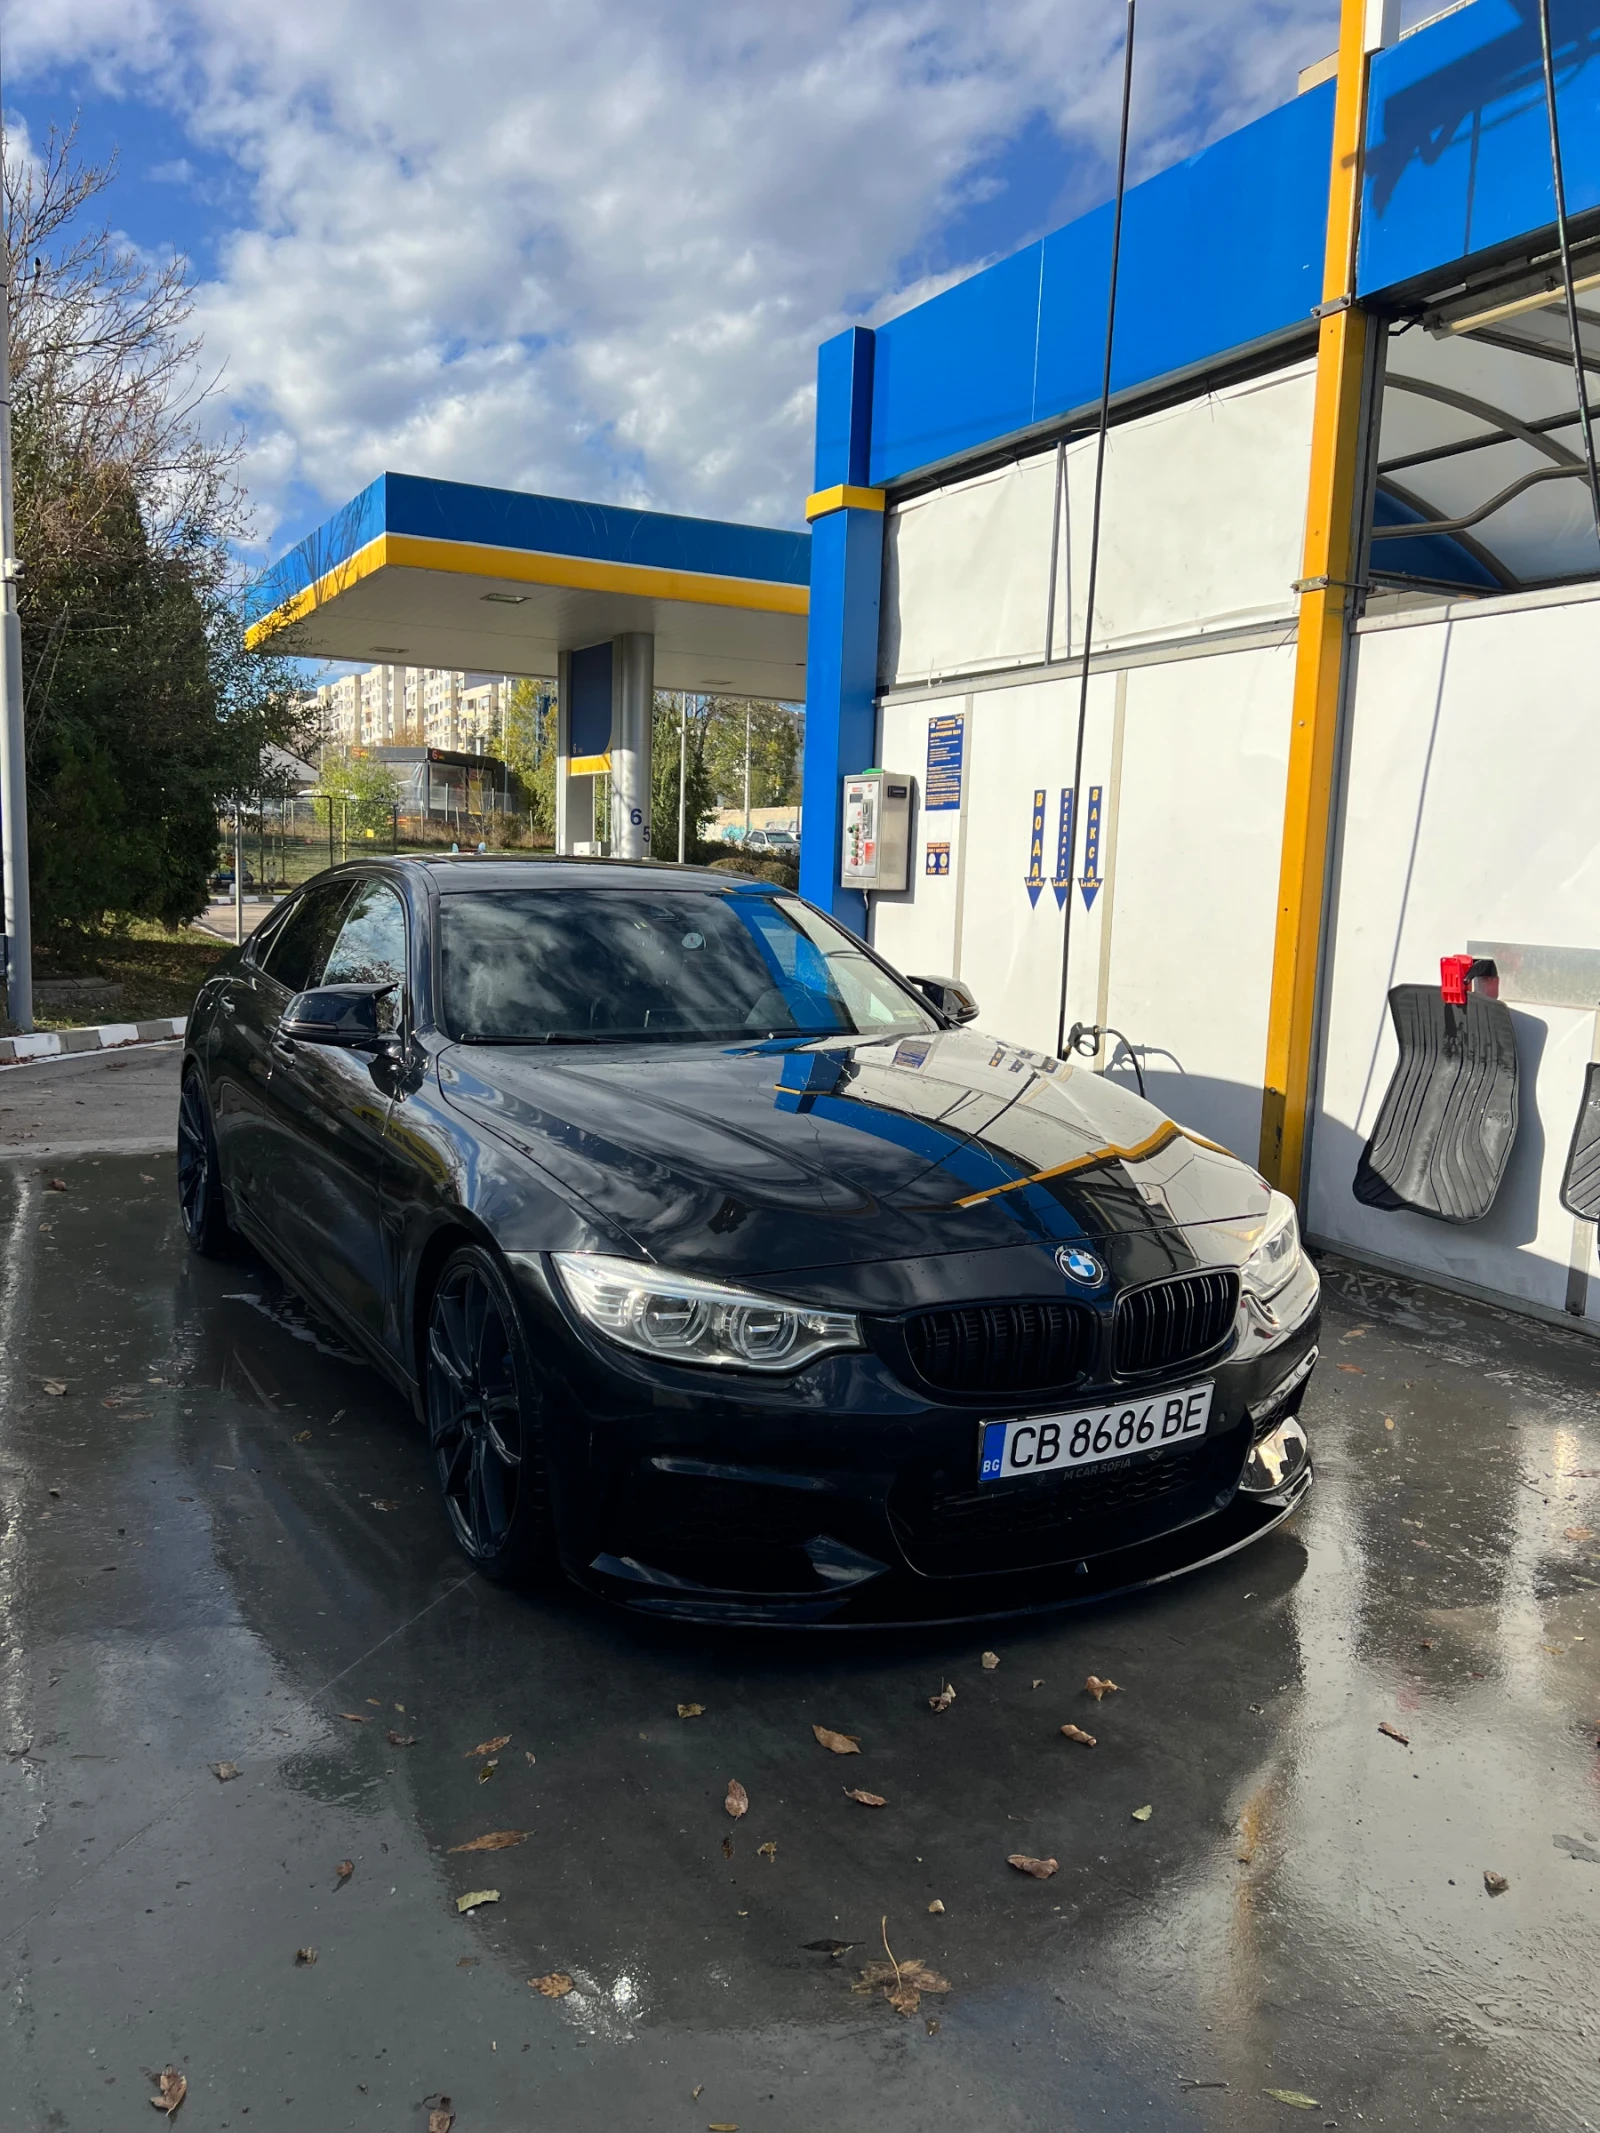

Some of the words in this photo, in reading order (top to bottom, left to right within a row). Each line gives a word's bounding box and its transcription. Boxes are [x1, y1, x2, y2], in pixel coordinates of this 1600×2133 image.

[630, 808, 643, 825] 6
[643, 825, 651, 842] 5
[1031, 792, 1044, 877] ВОДА
[1060, 790, 1070, 878] ПРЕПАРАТ
[1087, 788, 1099, 878] ВАКСА
[1009, 1422, 1062, 1468] CB
[1068, 1404, 1155, 1458] 8686
[1160, 1391, 1207, 1440] BE
[982, 1458, 1000, 1473] BG
[1075, 1464, 1099, 1478] CAR
[1100, 1458, 1131, 1473] SOFIA
